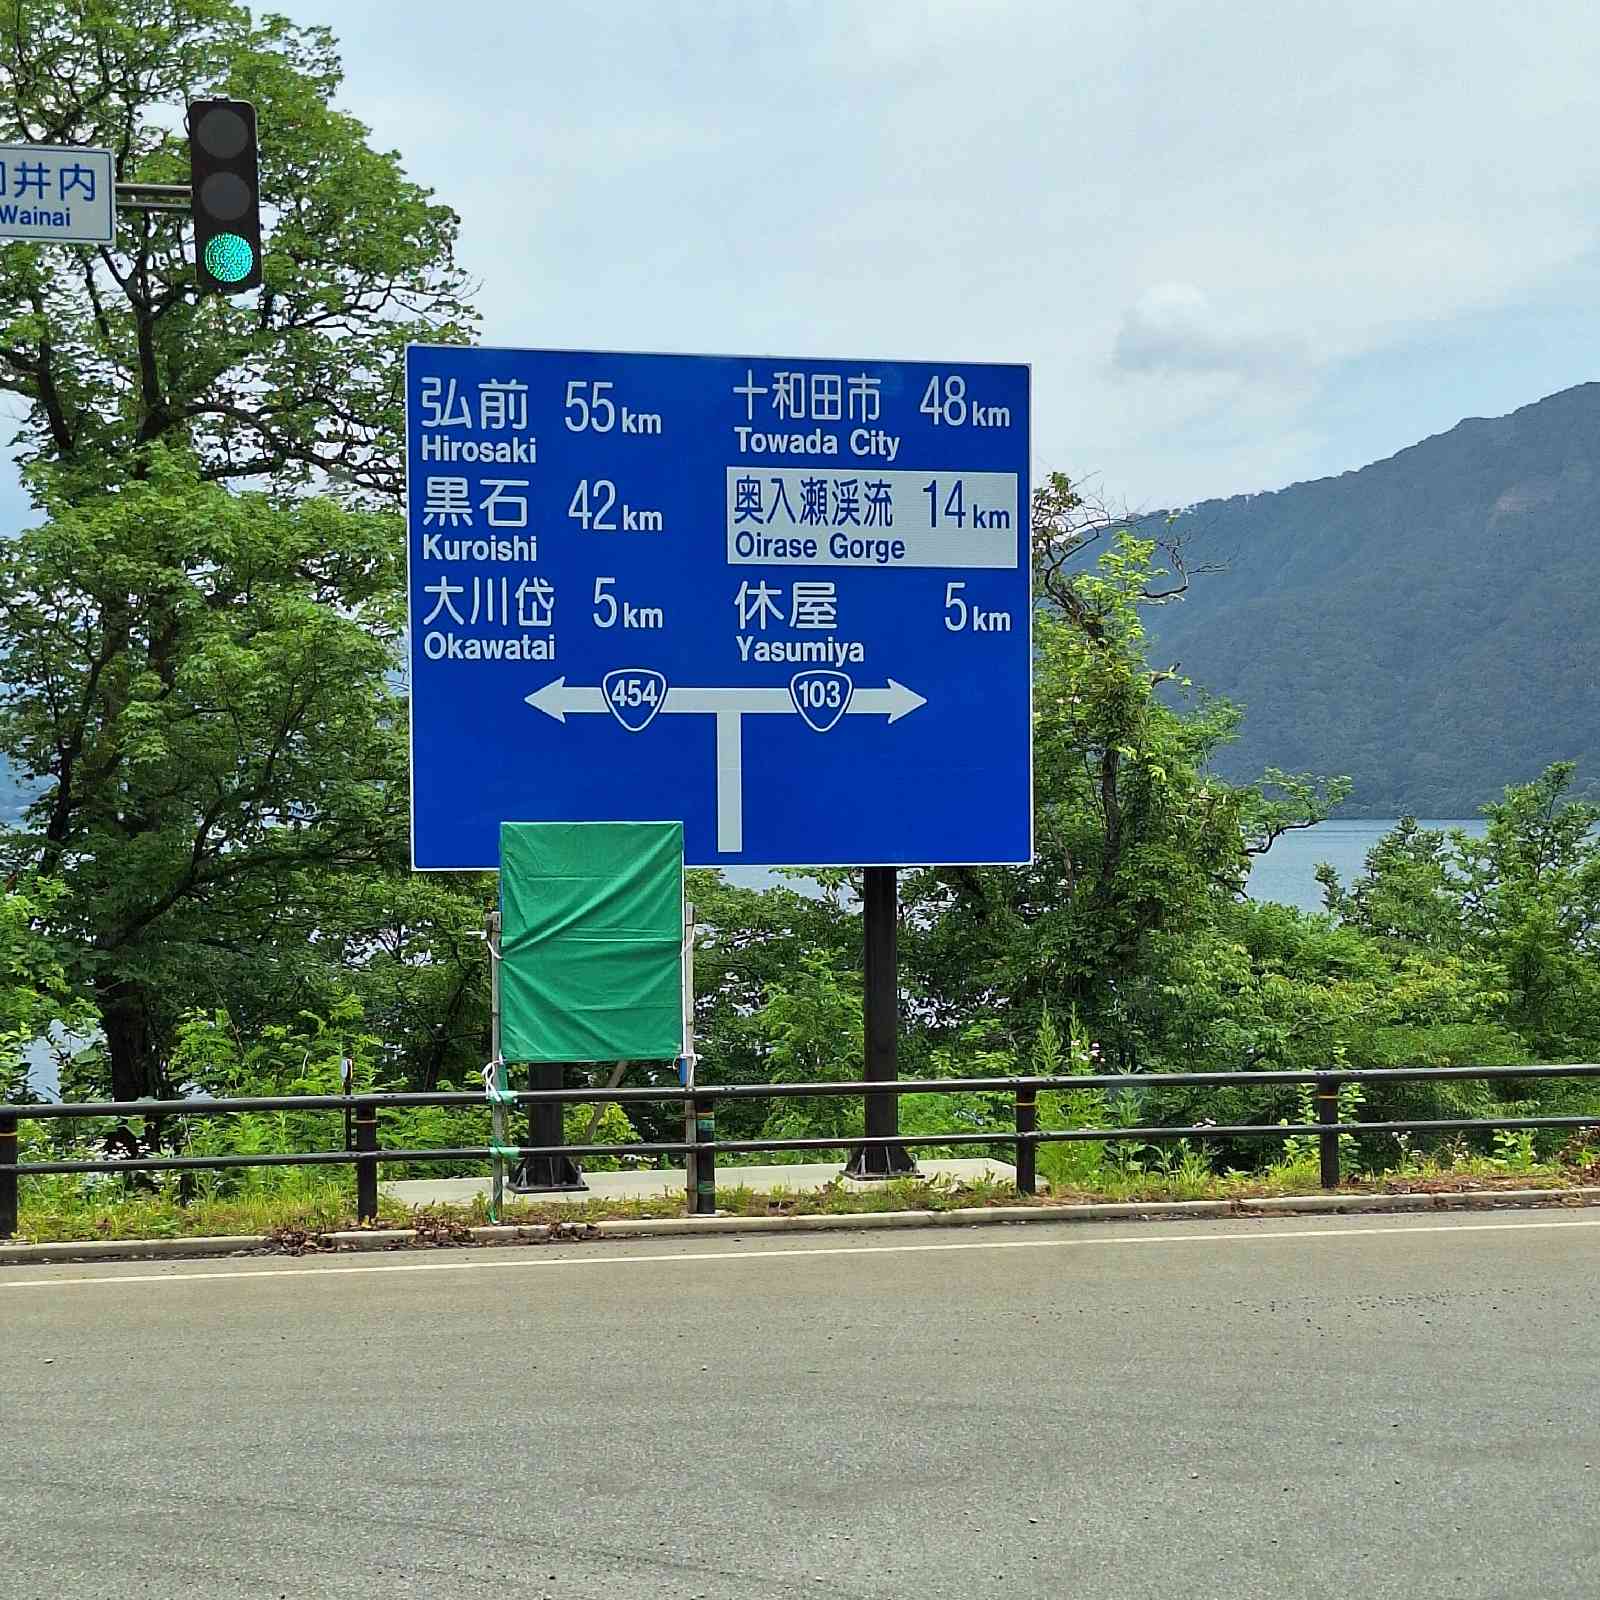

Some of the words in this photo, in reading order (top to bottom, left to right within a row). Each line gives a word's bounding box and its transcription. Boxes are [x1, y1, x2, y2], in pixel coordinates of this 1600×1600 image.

[0, 161, 96, 202] 井内
[0, 205, 71, 228] Wainai
[420, 376, 530, 431] 弘前
[733, 368, 882, 424] 十和田市
[421, 434, 537, 464] Hirosaki
[734, 426, 838, 456] Towada
[849, 427, 901, 462] City
[423, 476, 530, 528] 黒石
[734, 475, 893, 528] 奥入瀬渓流
[423, 533, 537, 562] Kuroishi
[735, 530, 818, 559] Oirase
[829, 532, 906, 564] Gorge
[423, 575, 555, 627] 大川岱
[734, 579, 838, 631] 休屋
[423, 631, 556, 661] Okawatai
[736, 635, 865, 668] Yasumiya
[611, 678, 659, 708] 454
[799, 680, 842, 708] 103
